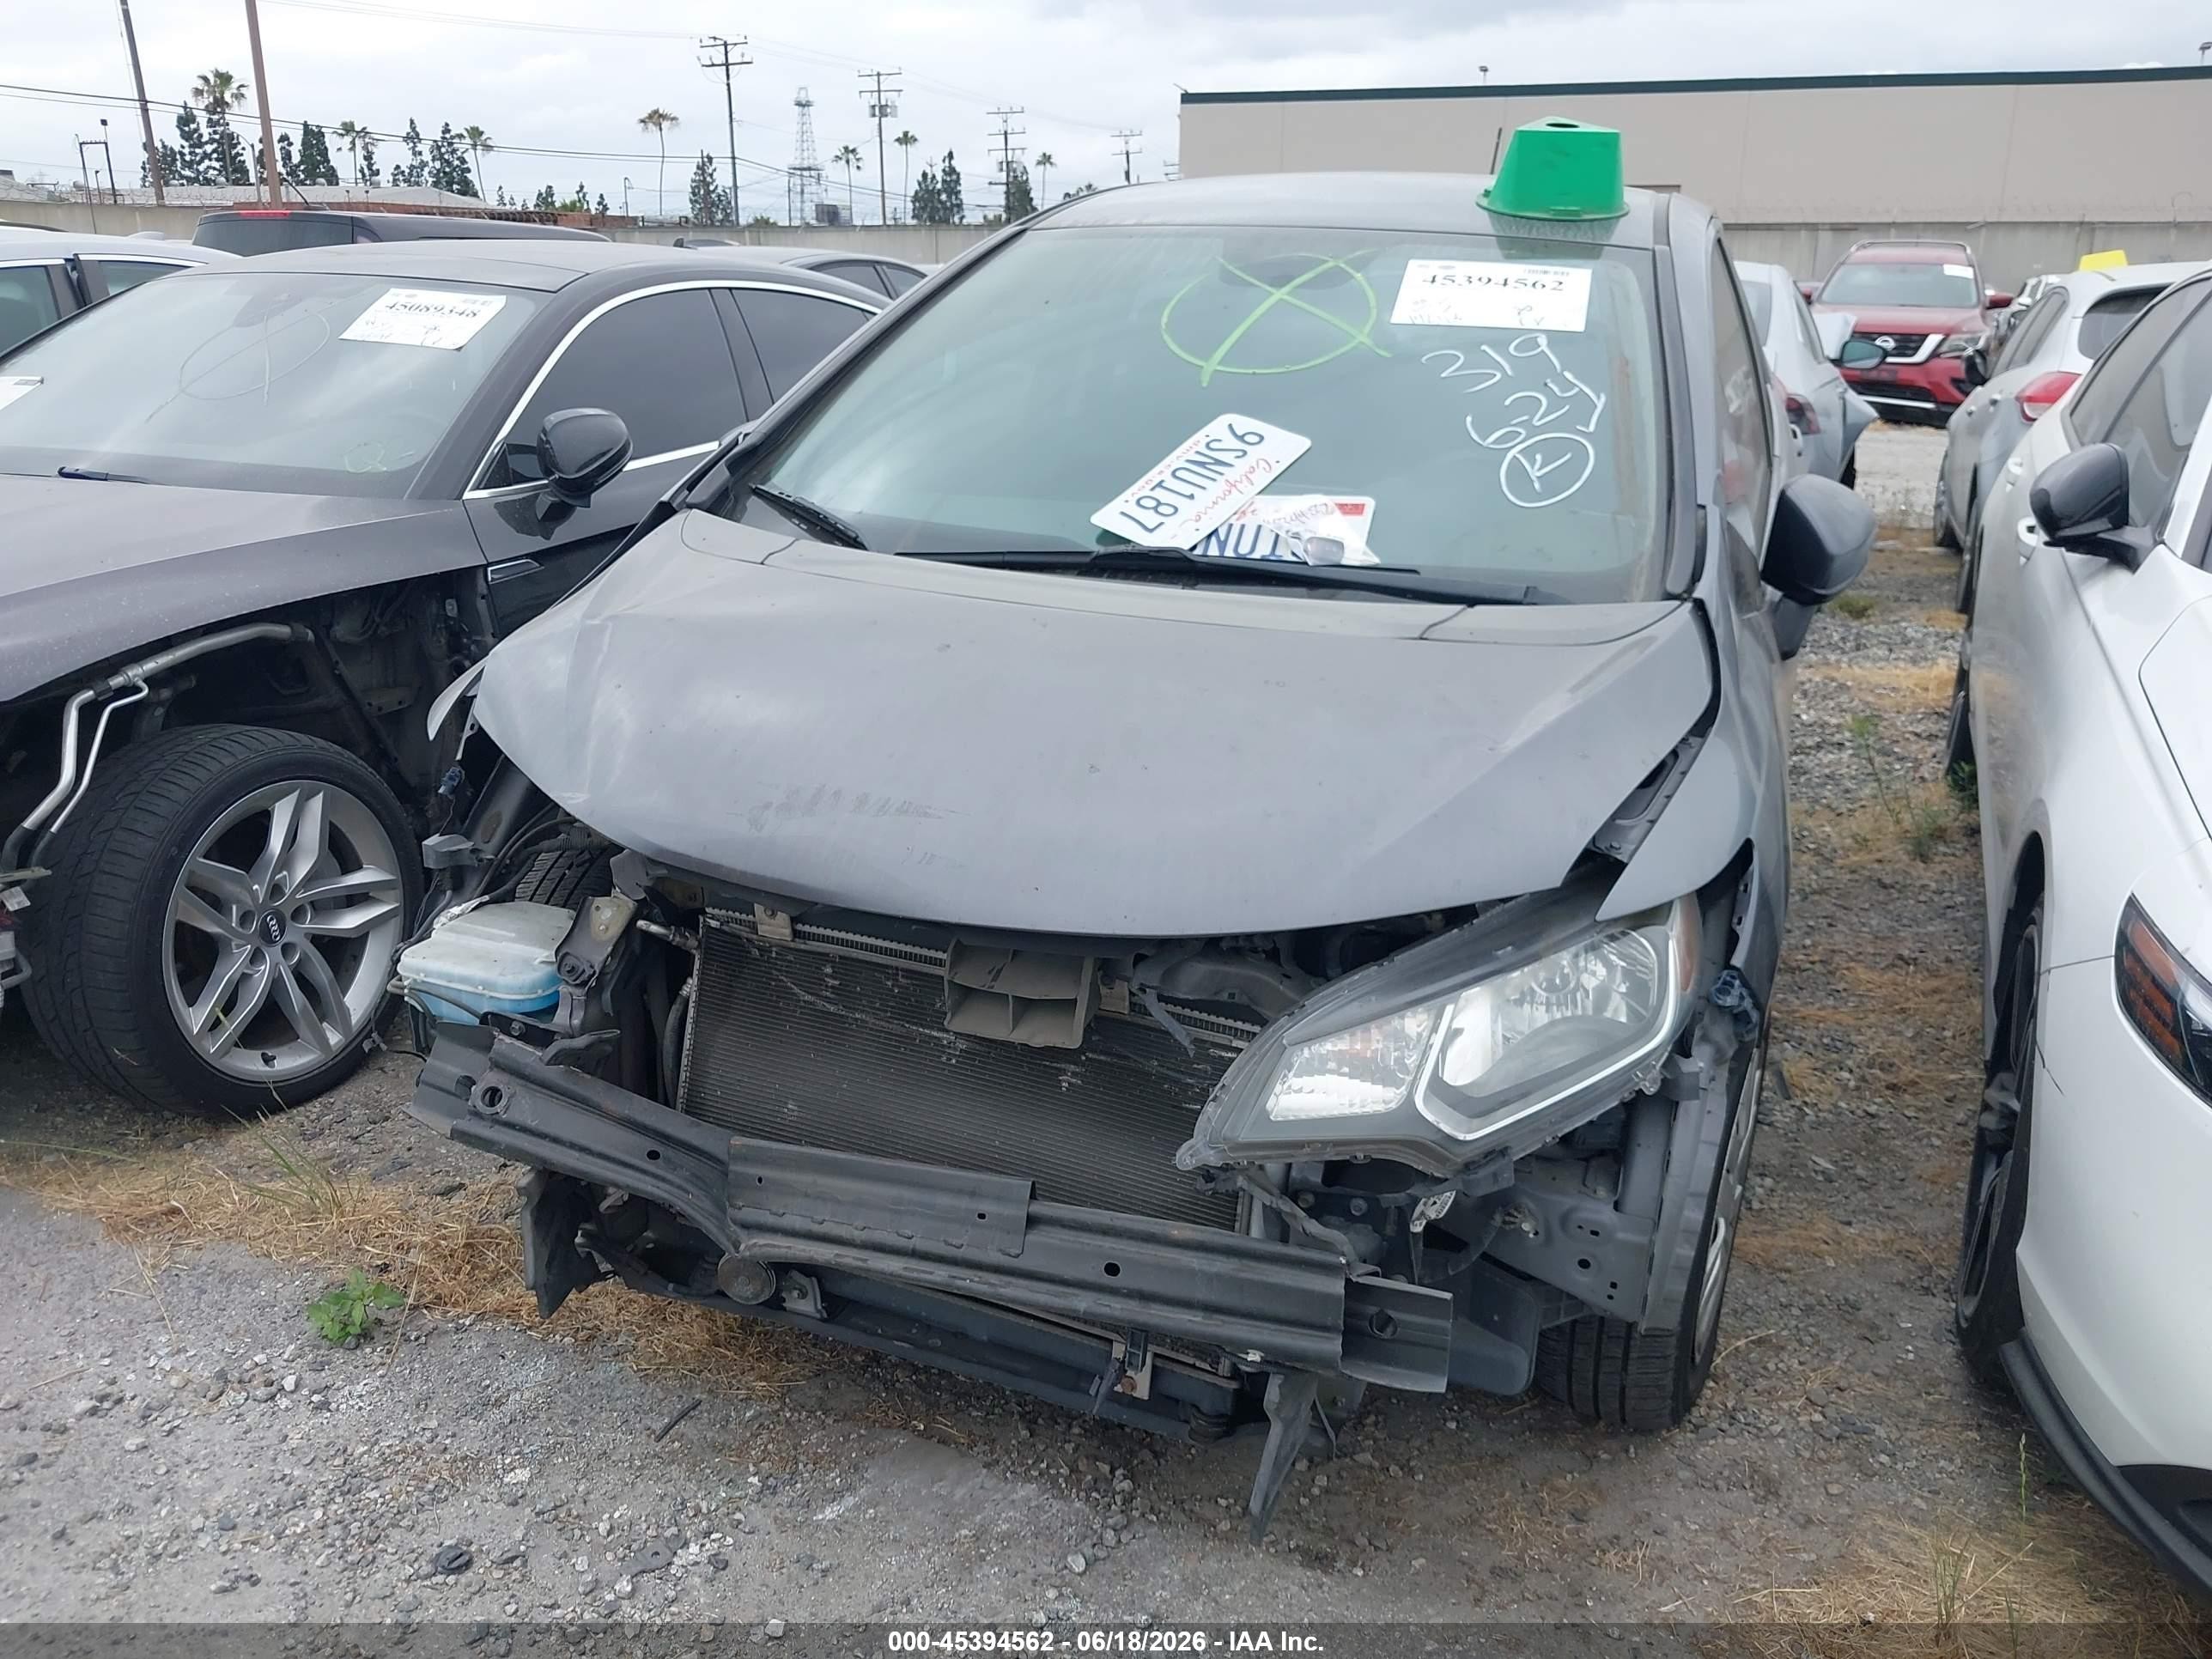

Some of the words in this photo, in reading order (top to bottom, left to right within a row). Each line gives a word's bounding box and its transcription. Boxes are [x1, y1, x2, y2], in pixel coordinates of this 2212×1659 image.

[1422, 274, 1565, 292] 45394562
[385, 301, 482, 319] 45089348
[1119, 422, 1265, 533] 9SNU187
[1179, 457, 1273, 527] California
[1197, 523, 1288, 559] NU1
